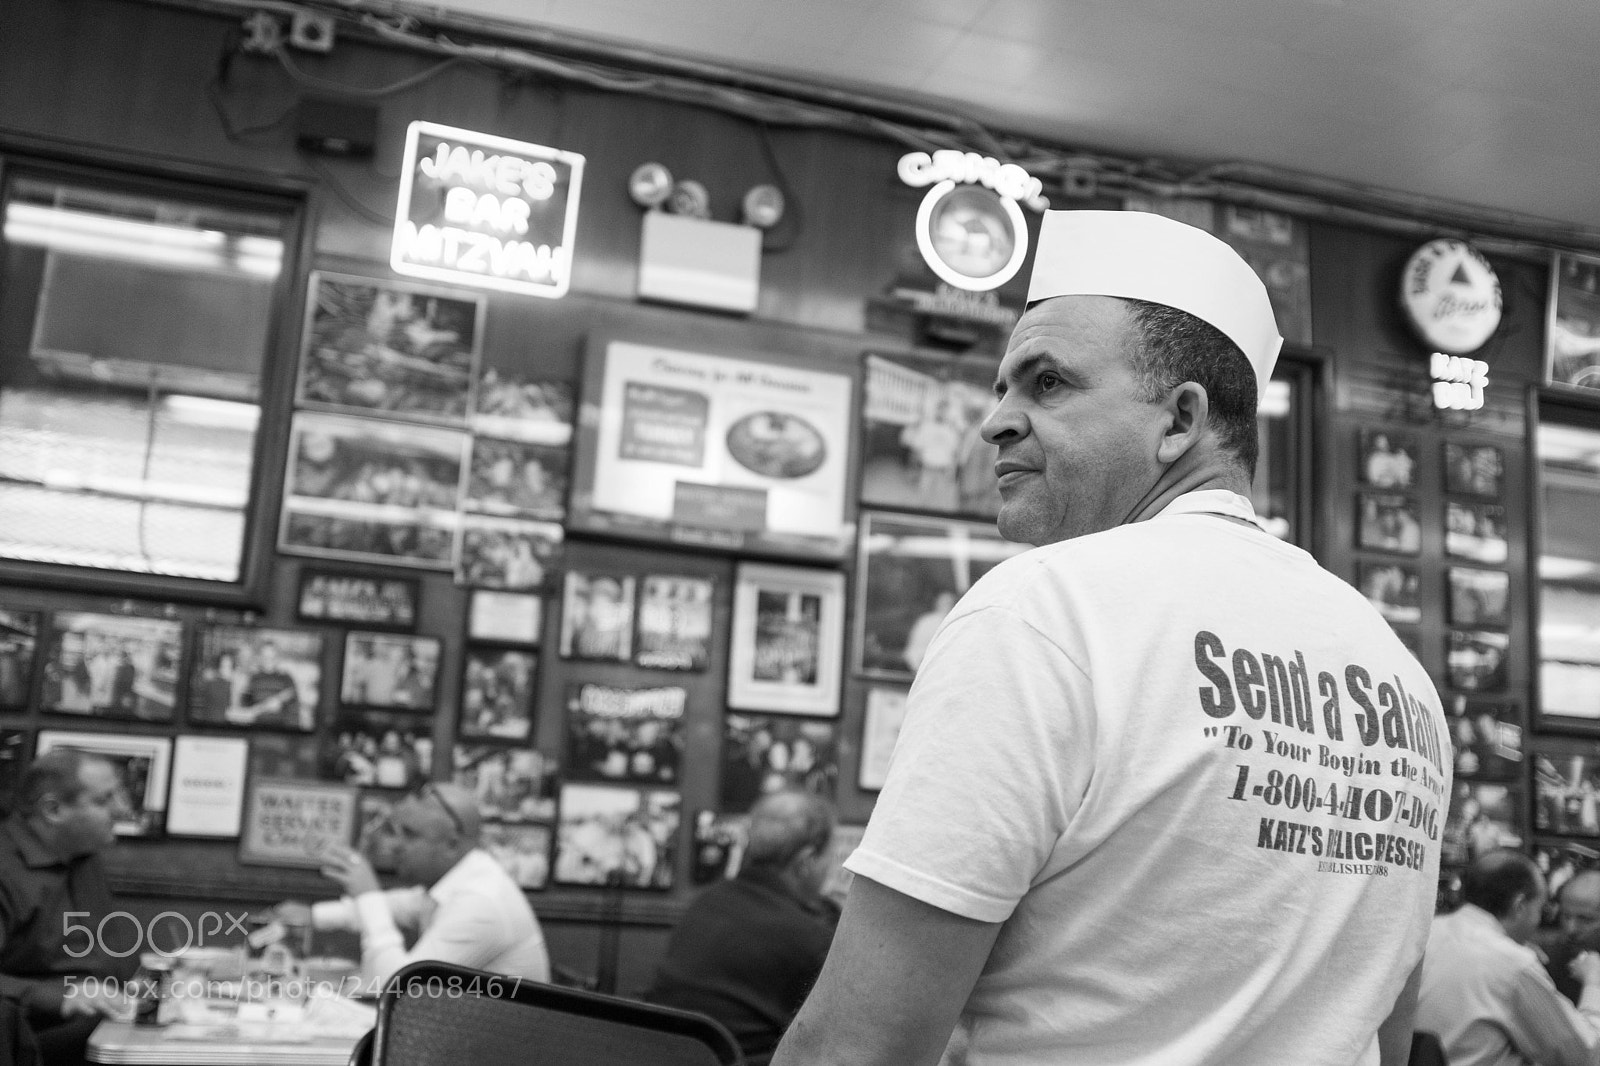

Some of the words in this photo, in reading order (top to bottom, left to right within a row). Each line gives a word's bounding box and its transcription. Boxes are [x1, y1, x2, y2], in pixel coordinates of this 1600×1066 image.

[420, 141, 557, 201] JAKE'S
[444, 186, 531, 235] BAR
[400, 220, 564, 282] MITZVAH
[1194, 630, 1315, 735] Send
[1317, 670, 1344, 741] a
[1261, 729, 1312, 763] Your
[1357, 752, 1382, 776] in
[1390, 756, 1418, 782] the
[1257, 817, 1324, 857] KATZ'S
